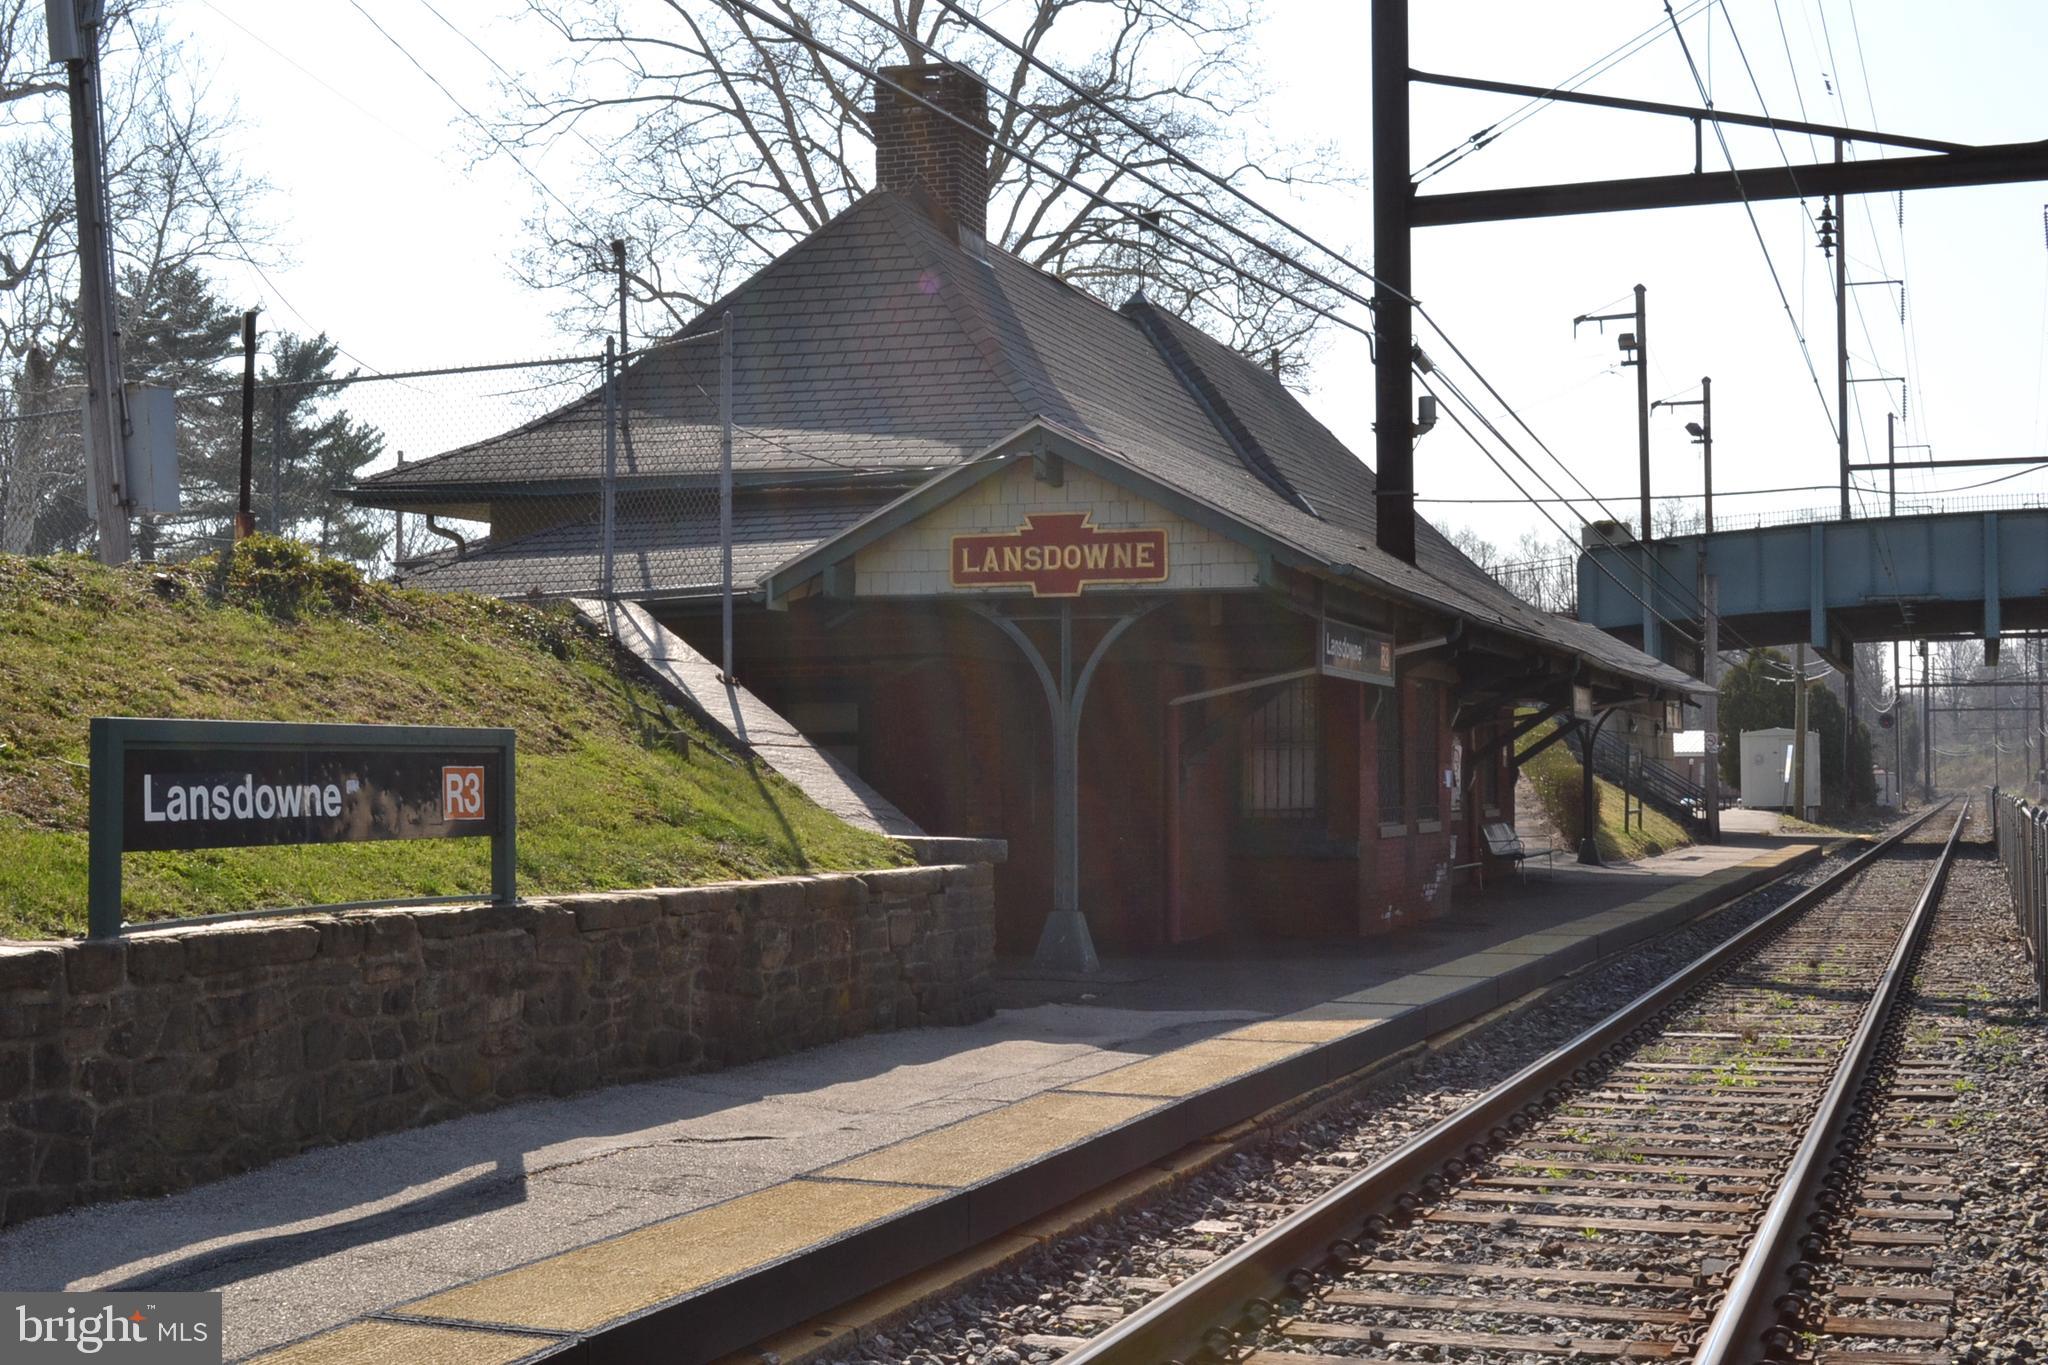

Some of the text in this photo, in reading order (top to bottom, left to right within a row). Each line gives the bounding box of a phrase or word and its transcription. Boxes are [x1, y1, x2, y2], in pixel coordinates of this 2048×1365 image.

[961, 543, 1155, 573] LANSDOWNE
[1326, 631, 1362, 662] Lansdowne
[143, 772, 482, 822] Lansdowne R3
